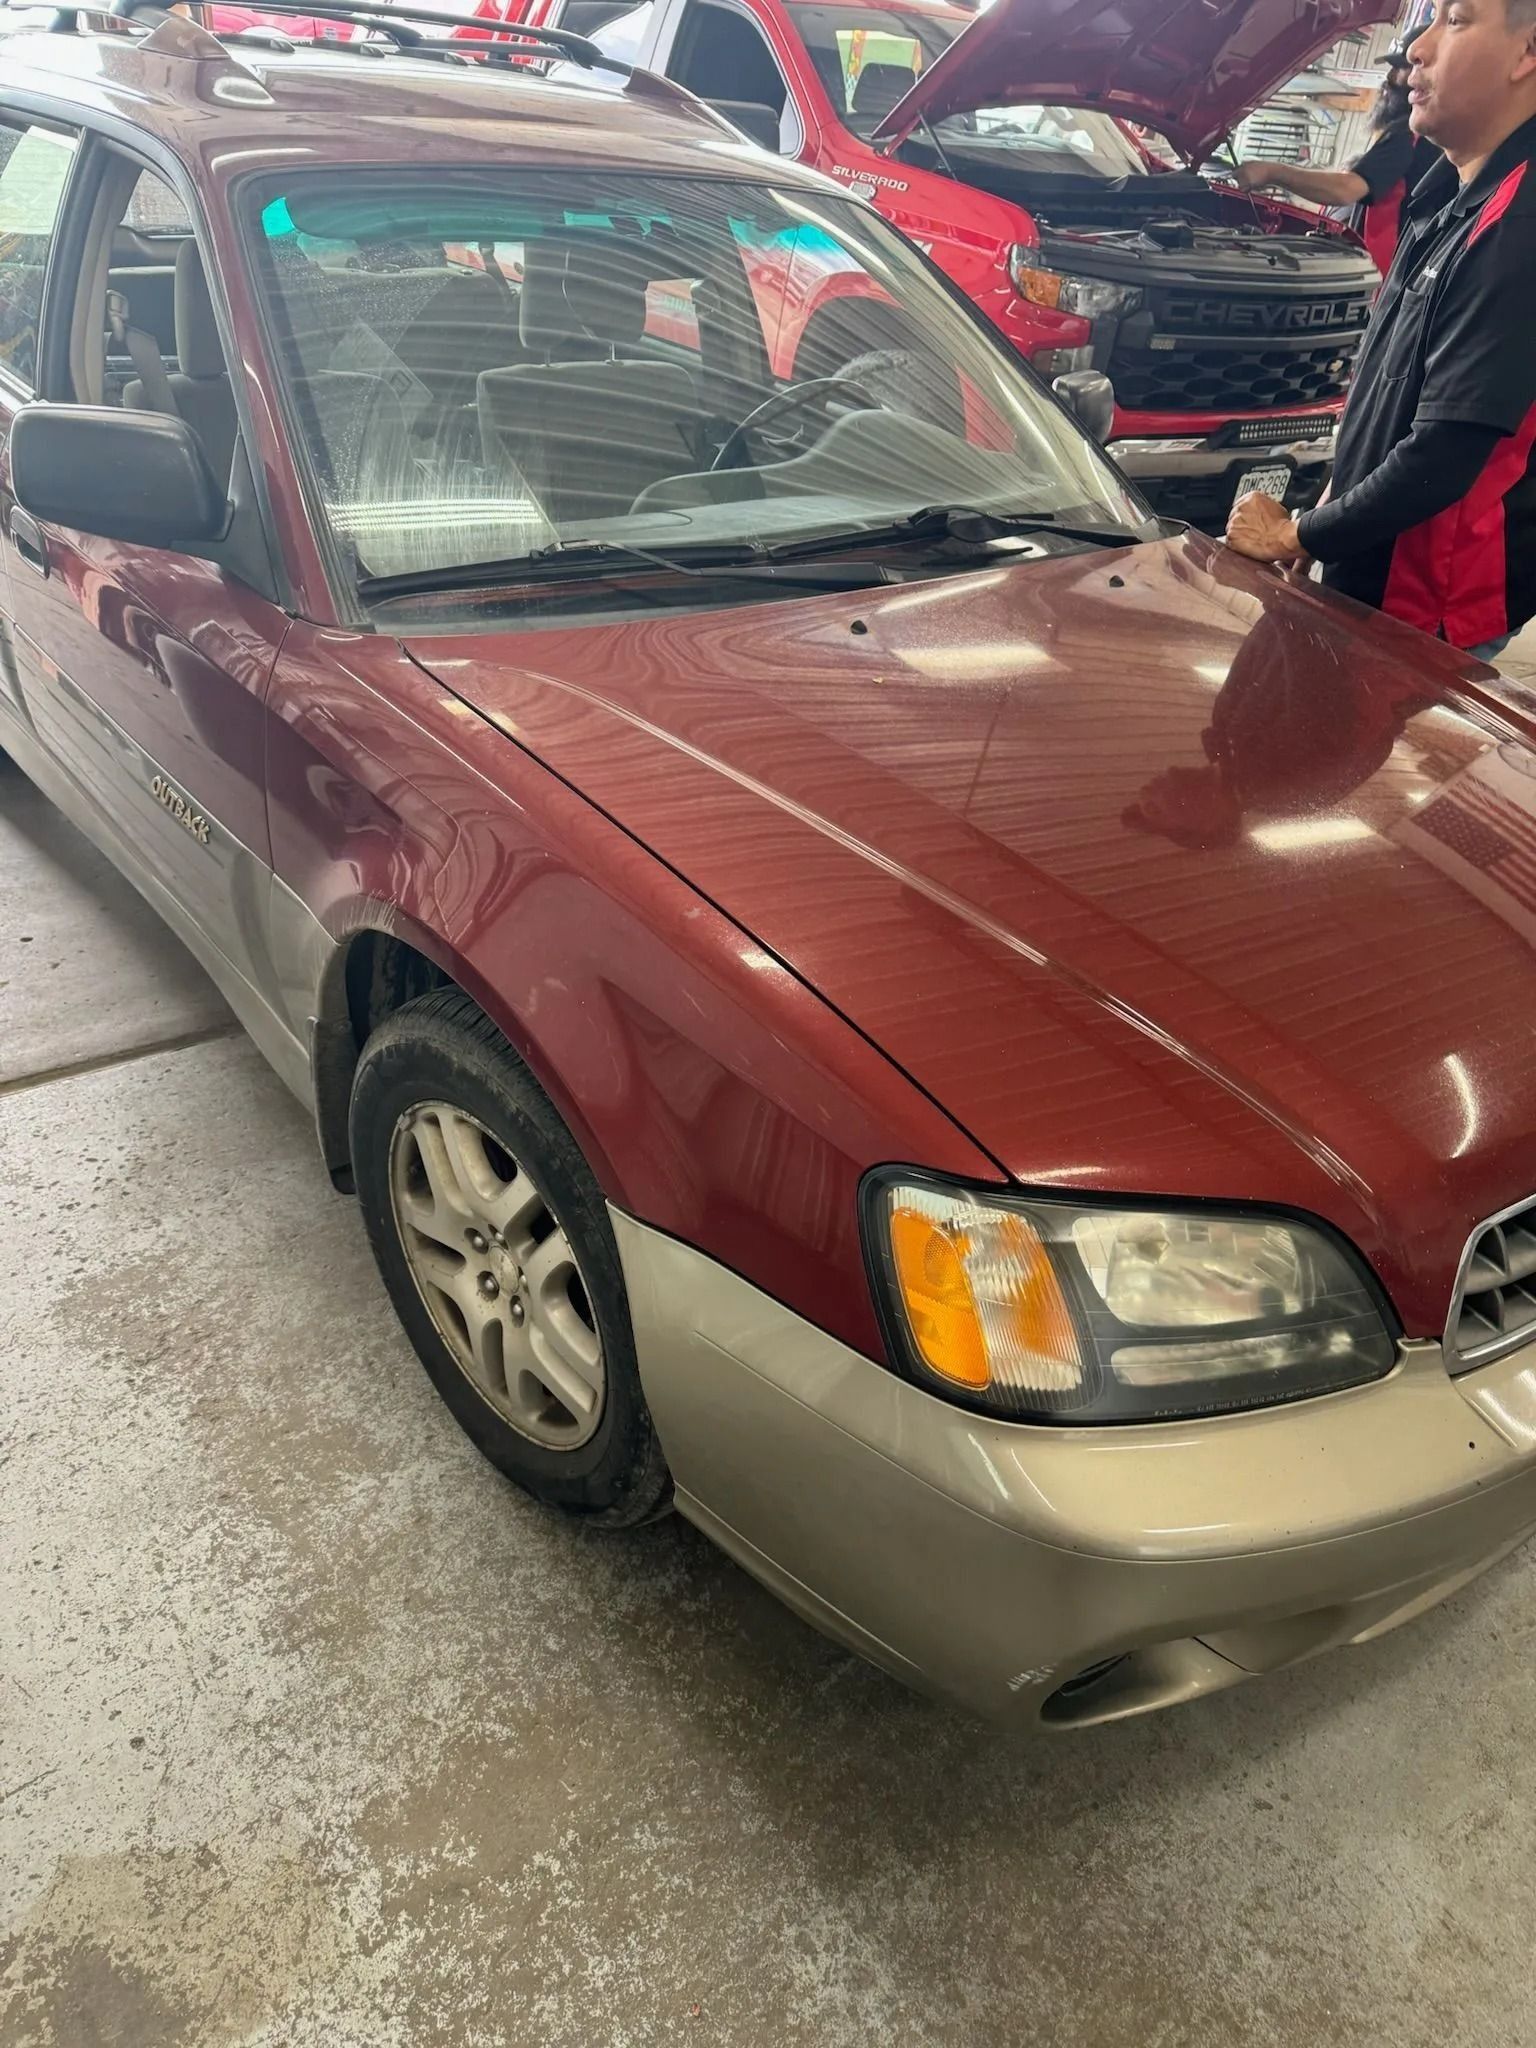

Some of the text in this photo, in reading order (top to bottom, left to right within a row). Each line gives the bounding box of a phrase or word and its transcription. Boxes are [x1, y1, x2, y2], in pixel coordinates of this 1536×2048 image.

[832, 165, 909, 191] SILVERADO
[1162, 300, 1374, 325] CHEVROLET
[152, 775, 209, 843] OUTBACK
